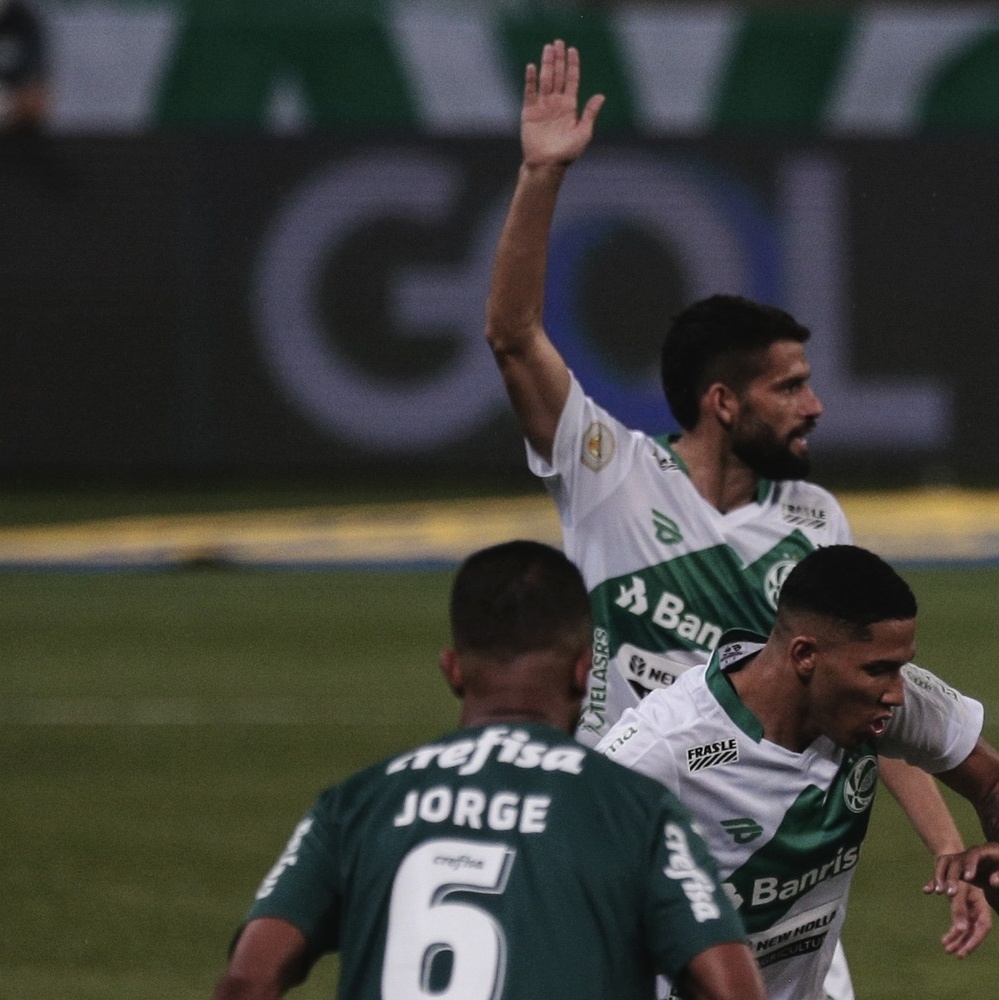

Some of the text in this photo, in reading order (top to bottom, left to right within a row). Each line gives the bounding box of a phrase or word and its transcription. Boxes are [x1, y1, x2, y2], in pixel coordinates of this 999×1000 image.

[254, 150, 955, 453] GOL
[387, 727, 587, 776] crefisa
[393, 786, 552, 834] JORGE
[756, 930, 793, 952] NEW
